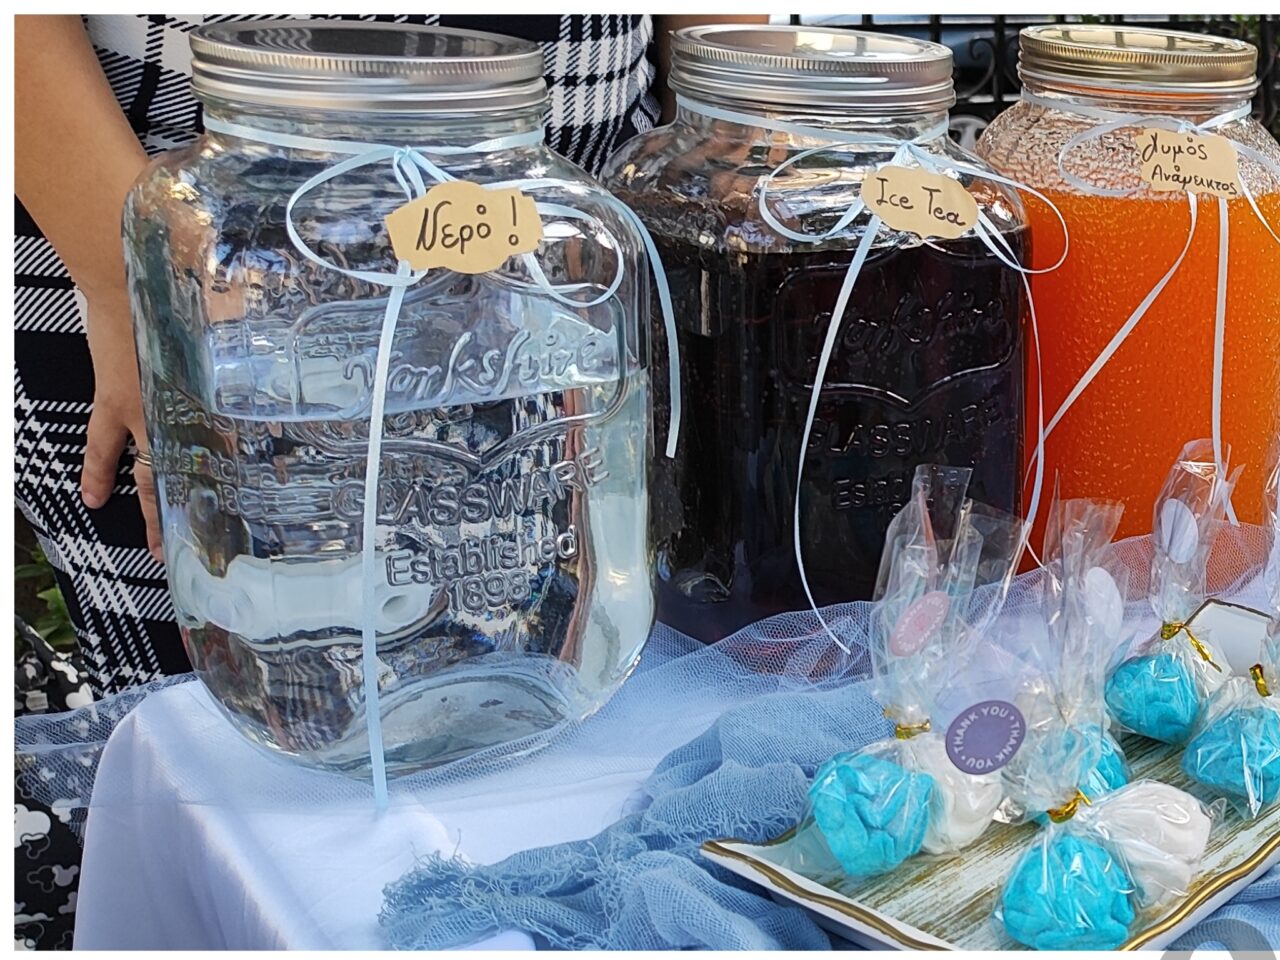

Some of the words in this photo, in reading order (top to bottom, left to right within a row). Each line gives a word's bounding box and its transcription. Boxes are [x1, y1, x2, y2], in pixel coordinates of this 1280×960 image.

[876, 177, 914, 209] Ice
[921, 186, 966, 226] Tea
[385, 524, 579, 587] Established
[981, 705, 1009, 718] YOU
[953, 712, 979, 754] THANK
[995, 721, 1020, 761] THANK
[965, 757, 993, 769] YOU
